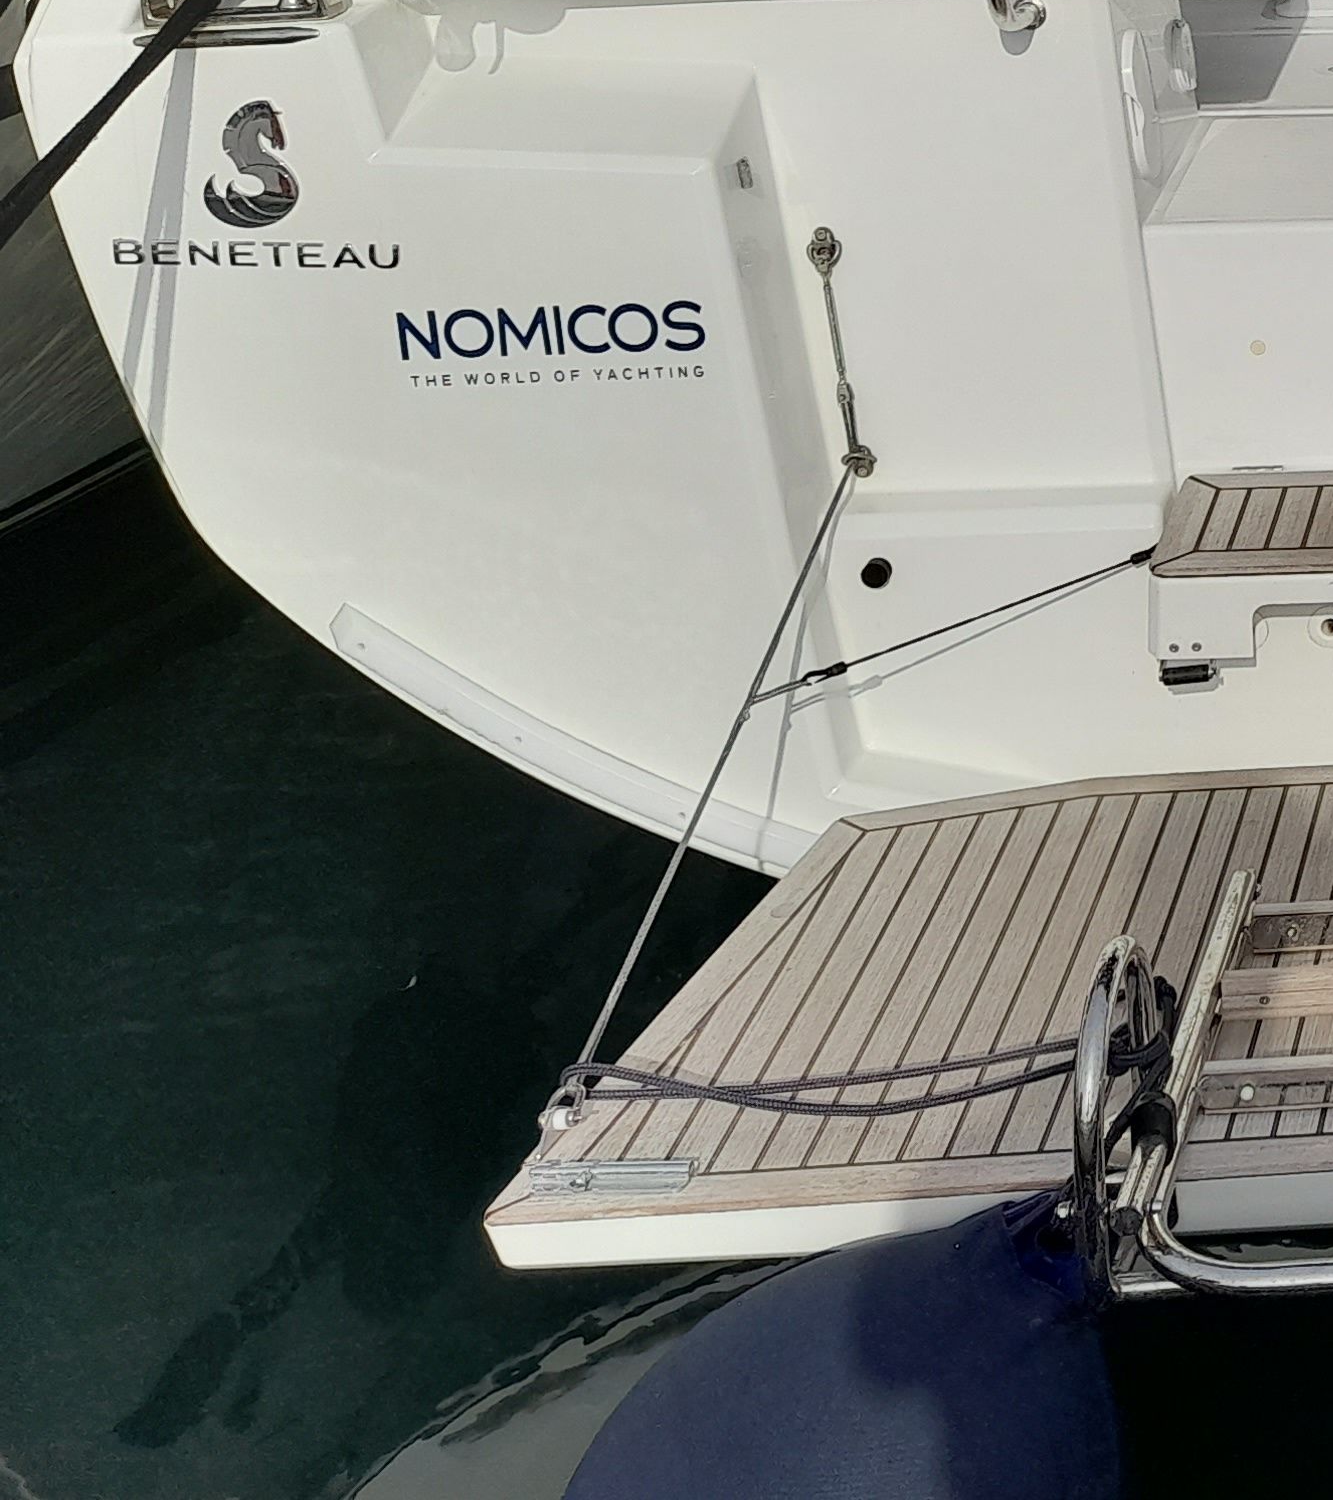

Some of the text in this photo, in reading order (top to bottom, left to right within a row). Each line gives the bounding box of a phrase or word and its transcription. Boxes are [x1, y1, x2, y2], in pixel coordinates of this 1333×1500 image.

[112, 238, 400, 269] BENETEAU
[396, 300, 706, 361] NOMICOS
[410, 365, 706, 388] THE WORLD OF YACHTING
